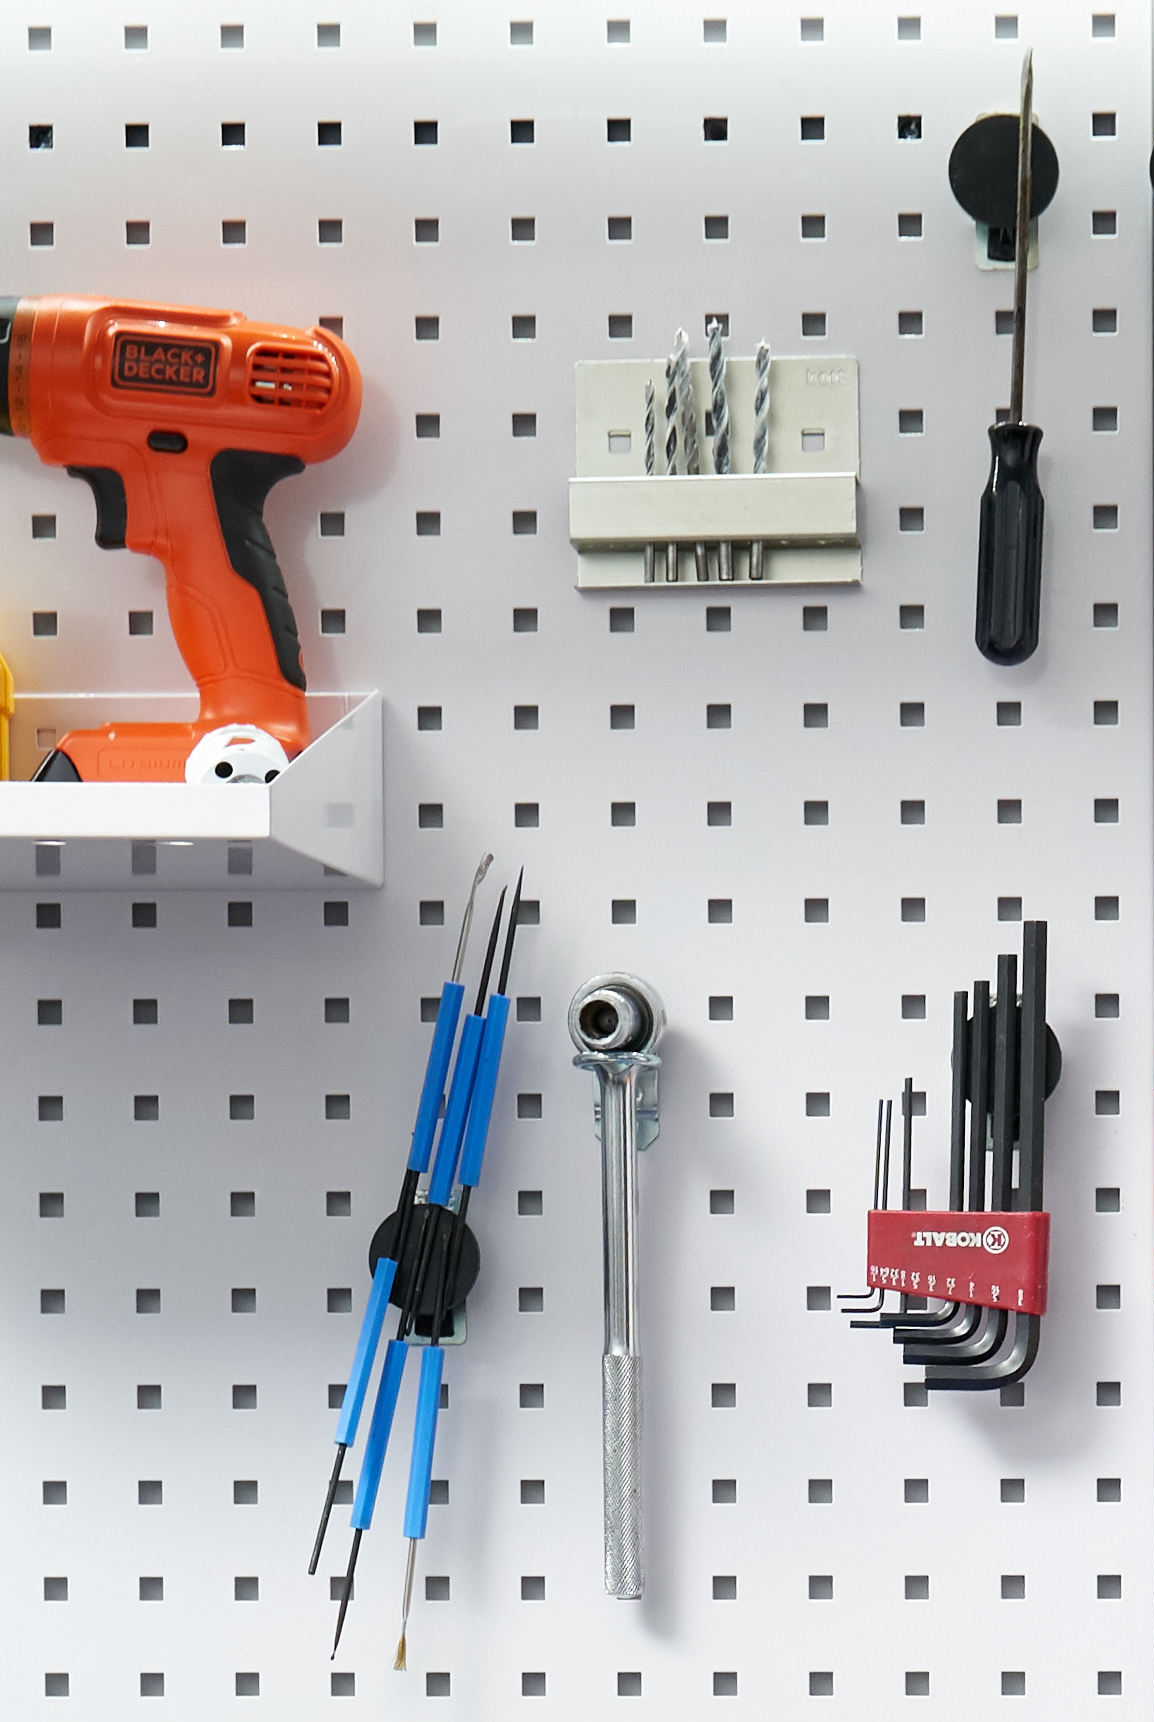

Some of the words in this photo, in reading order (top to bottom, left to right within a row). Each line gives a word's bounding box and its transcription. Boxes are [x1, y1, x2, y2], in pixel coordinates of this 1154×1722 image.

[124, 344, 206, 366] BLACK+
[123, 361, 206, 384] DECKER
[913, 1231, 982, 1248] KOBALT
